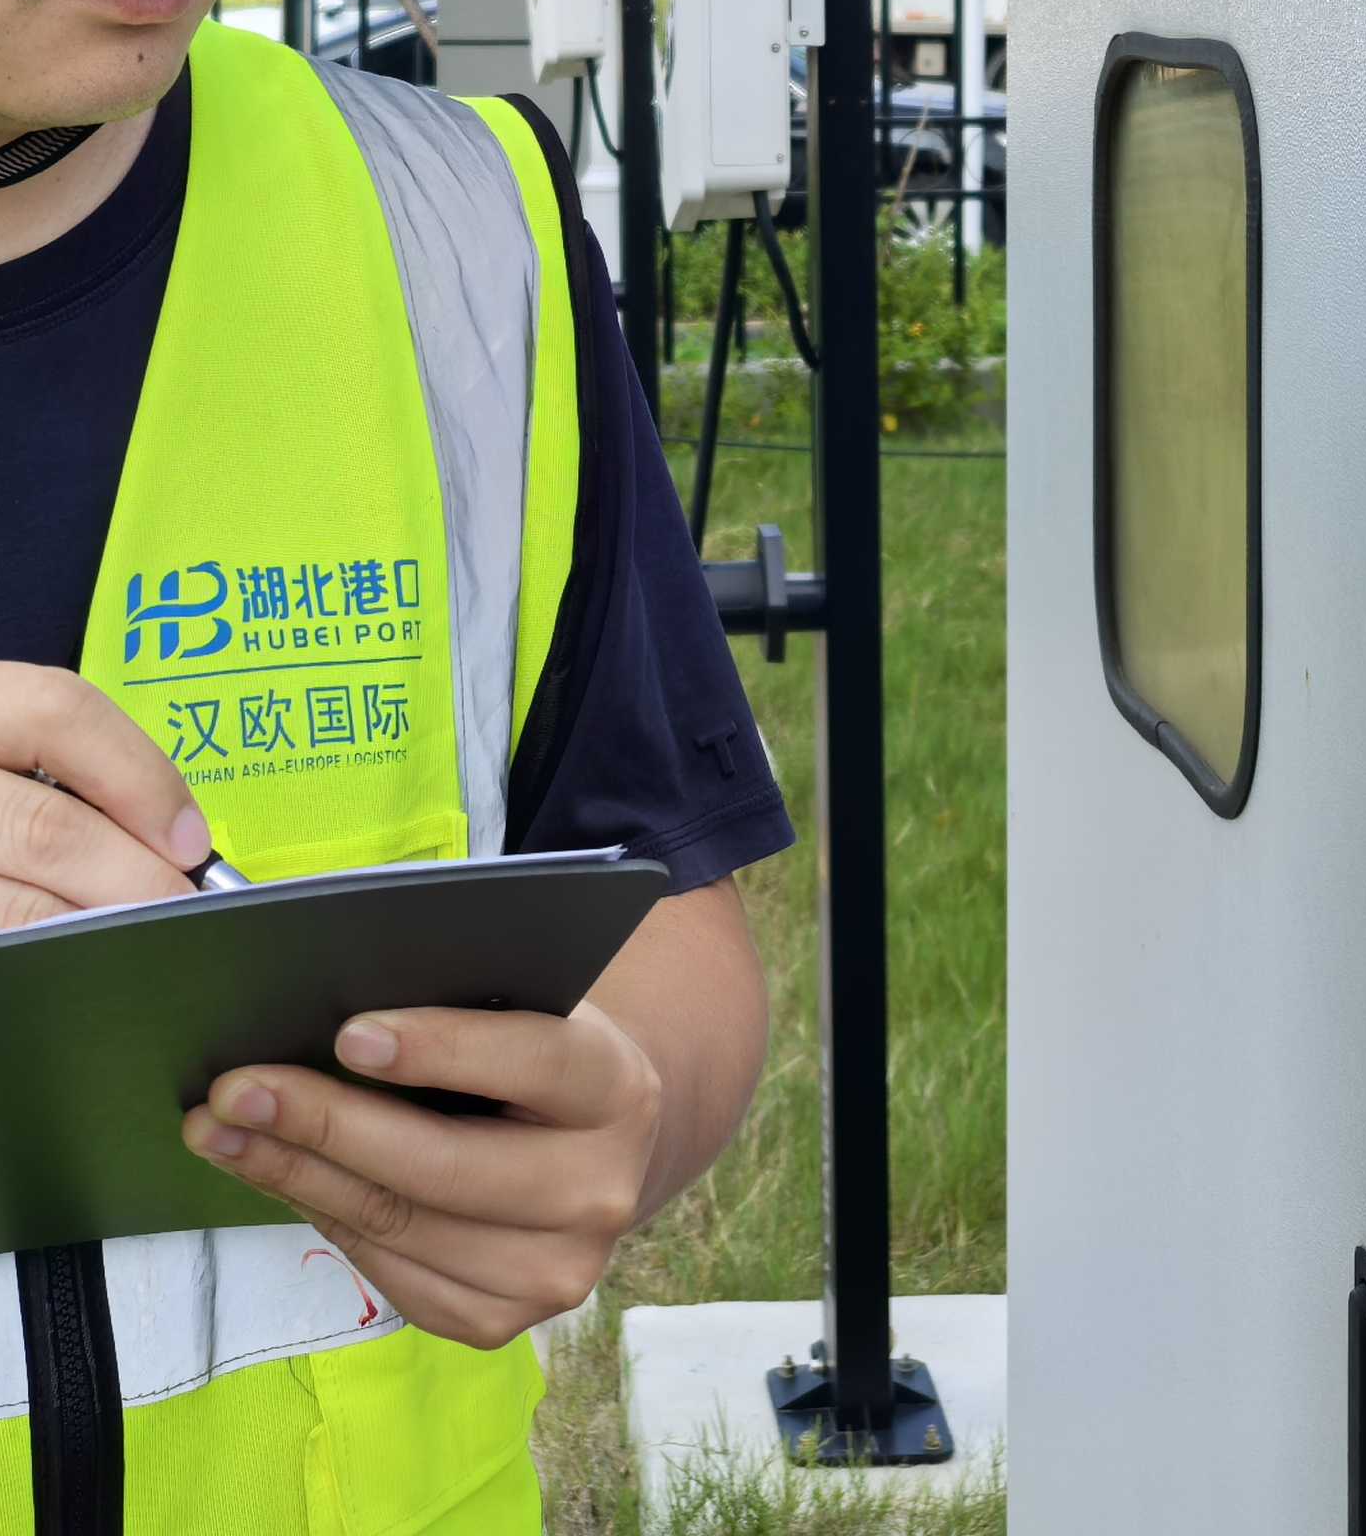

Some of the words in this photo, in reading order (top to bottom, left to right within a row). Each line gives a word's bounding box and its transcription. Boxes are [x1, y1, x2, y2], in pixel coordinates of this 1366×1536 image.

[236, 559, 420, 623] 湖北港口
[243, 626, 342, 653] HUBEI
[355, 620, 422, 645] PORT
[167, 683, 410, 763] 汉欧国际
[242, 754, 341, 778] ASIA-EUROPE
[346, 747, 408, 767] LOGISTICS
